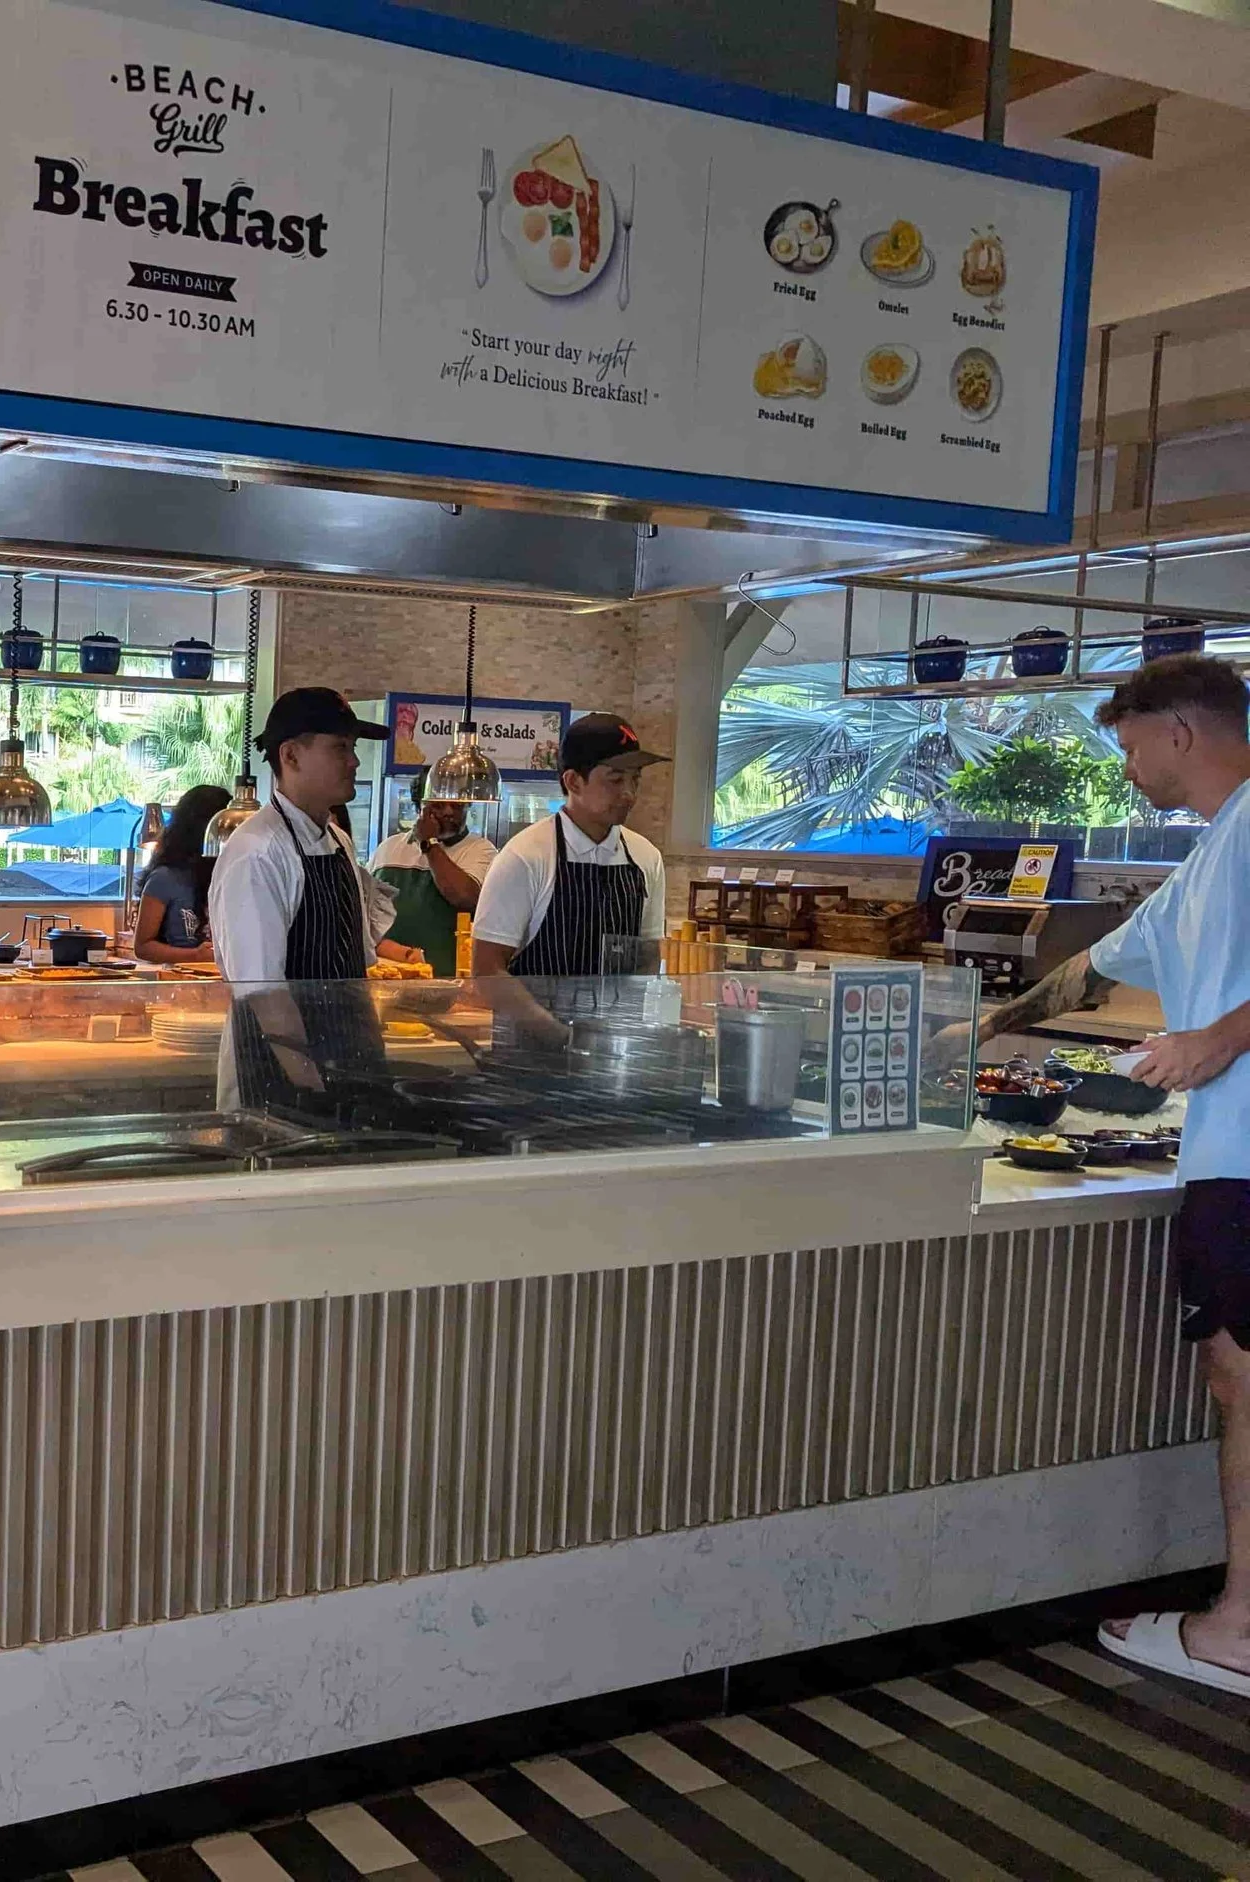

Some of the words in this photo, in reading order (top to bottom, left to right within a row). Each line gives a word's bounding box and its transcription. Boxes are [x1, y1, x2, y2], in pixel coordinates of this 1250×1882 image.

[123, 63, 255, 117] BEACH
[150, 102, 228, 157] Grill
[32, 155, 329, 259] Breakfast
[142, 269, 180, 289] OPEN
[184, 274, 224, 294] DAILY
[773, 281, 798, 297] Fried
[799, 285, 817, 302] Egg
[105, 299, 149, 323] 6.30
[167, 308, 222, 333] 10.30
[224, 315, 256, 338] AM
[878, 300, 910, 315] Omelet
[952, 312, 968, 328] Egg
[514, 338, 551, 357] your
[554, 341, 583, 365] day
[587, 337, 638, 383] right
[440, 354, 477, 388] with
[479, 368, 488, 382] a
[493, 365, 568, 393] Delicious
[757, 408, 797, 424] Poached
[797, 411, 815, 429] Egg
[860, 422, 890, 437] Boiled
[890, 426, 907, 441] Egg
[940, 433, 985, 449] Scrambled
[984, 437, 1001, 454] Egg
[421, 719, 452, 736] Cold
[480, 723, 492, 738] &
[494, 723, 536, 740] Salads
